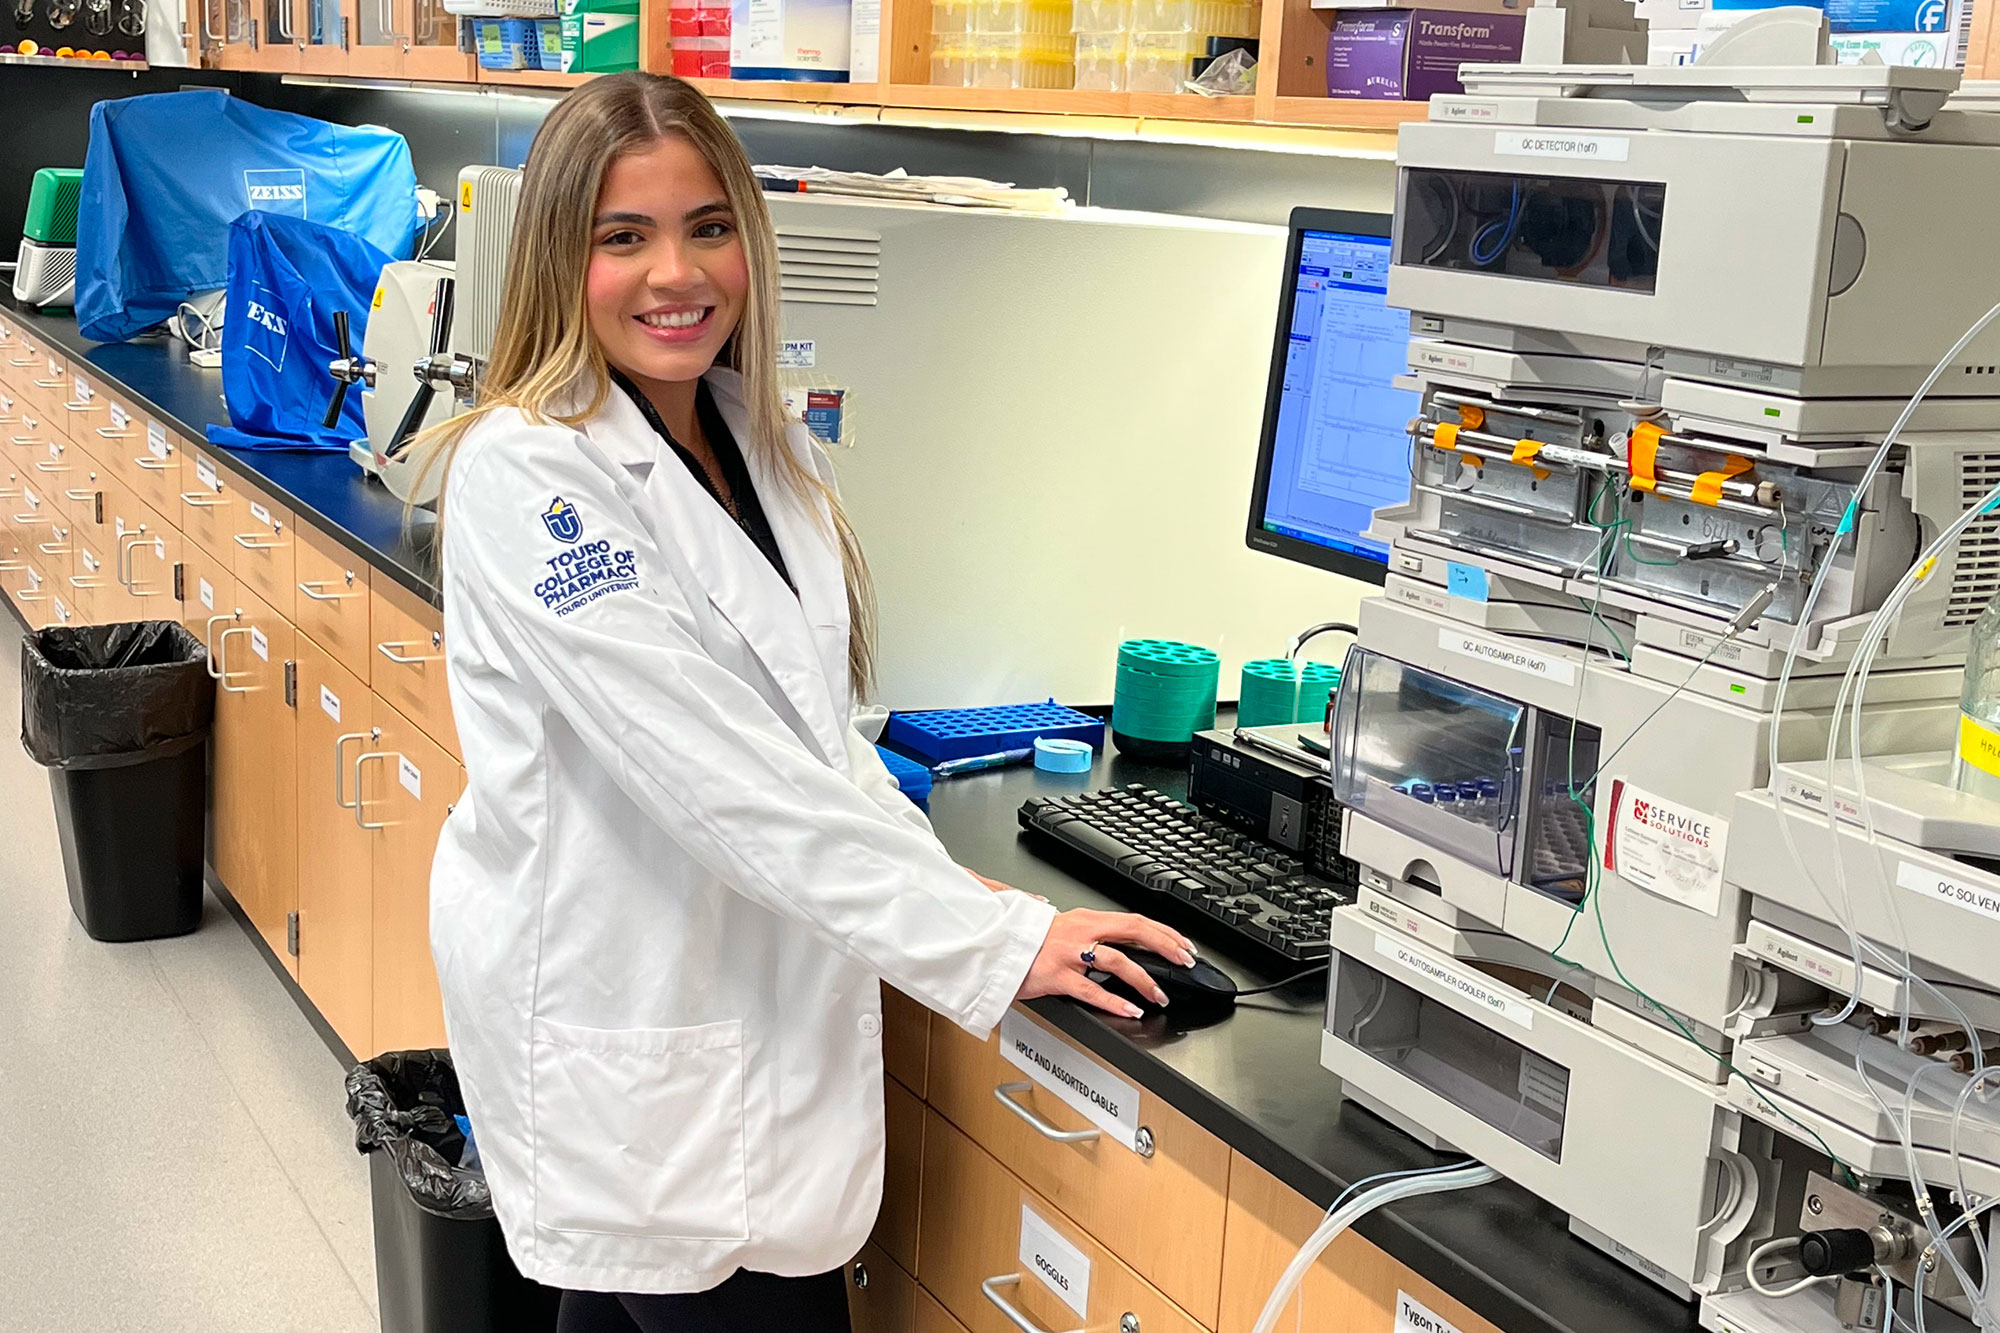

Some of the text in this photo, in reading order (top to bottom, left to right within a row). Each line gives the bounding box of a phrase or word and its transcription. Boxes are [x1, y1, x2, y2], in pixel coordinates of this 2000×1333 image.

[1336, 20, 1376, 35] Transform
[1391, 22, 1402, 38] S
[1420, 21, 1490, 39] Transform
[1522, 138, 1534, 150] QC
[1535, 139, 1576, 152] DETECTOR
[250, 185, 303, 200] ZEISS
[785, 342, 813, 351] PM KIT
[546, 540, 610, 572] TOURO
[534, 550, 635, 597] COLLEGE OF
[543, 563, 637, 609] PHARMACY
[555, 581, 640, 617] TOURO UNIVERSITY
[1463, 640, 1474, 652] QC
[1474, 644, 1527, 666] AUTOSAMPLER
[1801, 789, 1822, 803] Agilent
[1649, 820, 1709, 848] SOLUTIONS
[1651, 806, 1711, 839] SERVICE
[1938, 882, 2000, 913] QC SOLVEN
[1777, 947, 1798, 961] Agilent
[1398, 949, 1409, 963] QC
[1409, 954, 1457, 987] AUTOSAMPLER
[1458, 977, 1486, 1001] COOLER
[1016, 1039, 1119, 1118] HPLC AND ASSORTED CABLES
[1757, 1103, 1777, 1118] Agilent
[1035, 1254, 1069, 1291] GOGGLES
[1403, 1302, 1433, 1333] Tygon
